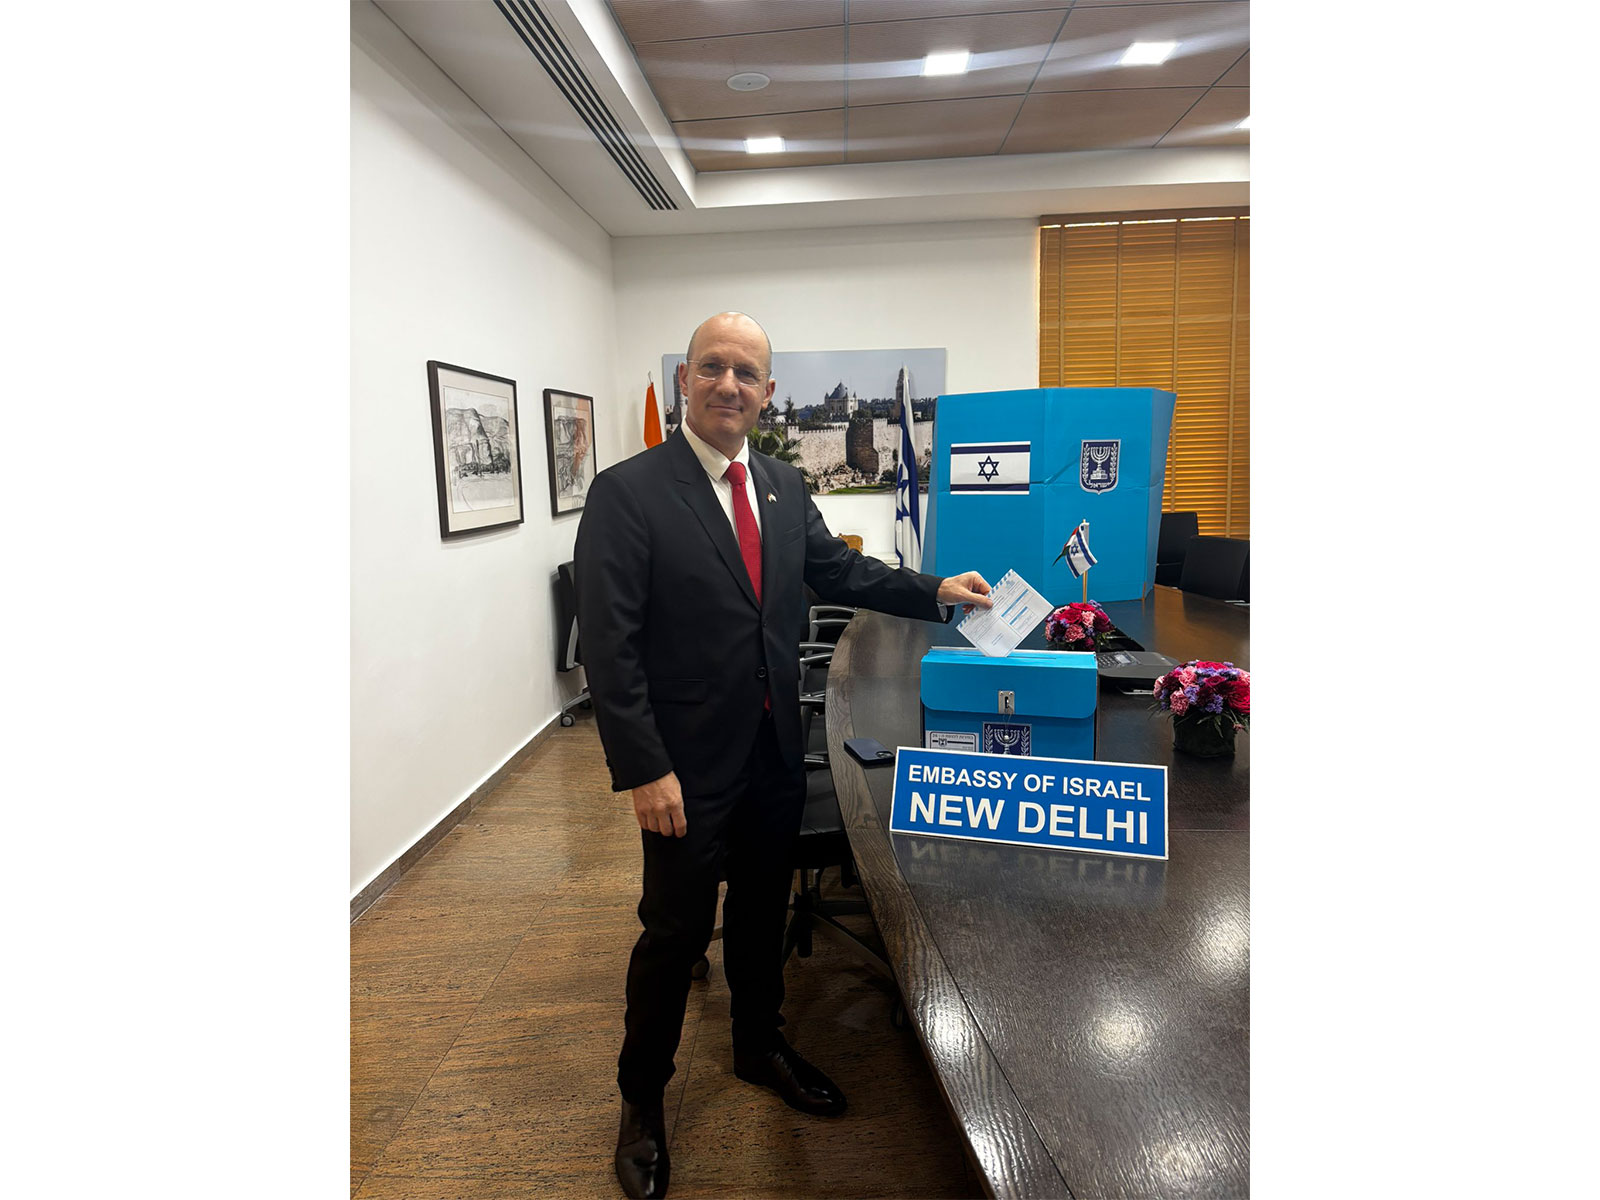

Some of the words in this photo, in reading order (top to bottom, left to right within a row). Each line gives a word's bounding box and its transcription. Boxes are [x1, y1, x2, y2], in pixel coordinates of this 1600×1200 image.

[908, 764, 1018, 790] EMBASSY
[1023, 774, 1056, 793] OF
[1062, 777, 1151, 802] ISRAEL
[909, 791, 1005, 831] NEW
[1017, 801, 1148, 845] DELHI
